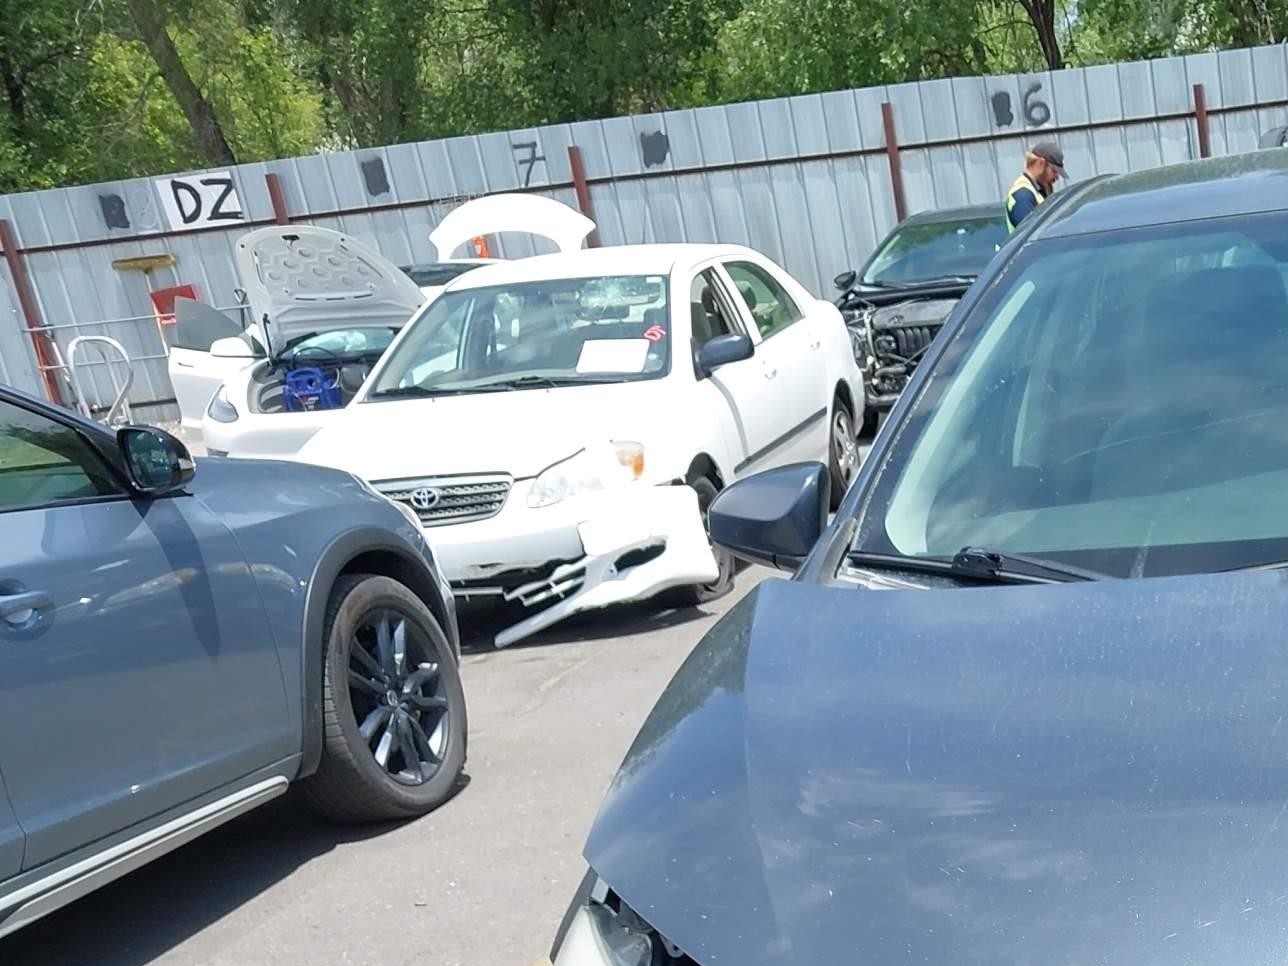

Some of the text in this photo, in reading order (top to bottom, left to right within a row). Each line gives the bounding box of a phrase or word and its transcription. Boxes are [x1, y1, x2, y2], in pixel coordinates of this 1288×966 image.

[1024, 83, 1051, 127] 6
[512, 141, 546, 187] 7
[171, 178, 244, 224] DZ
